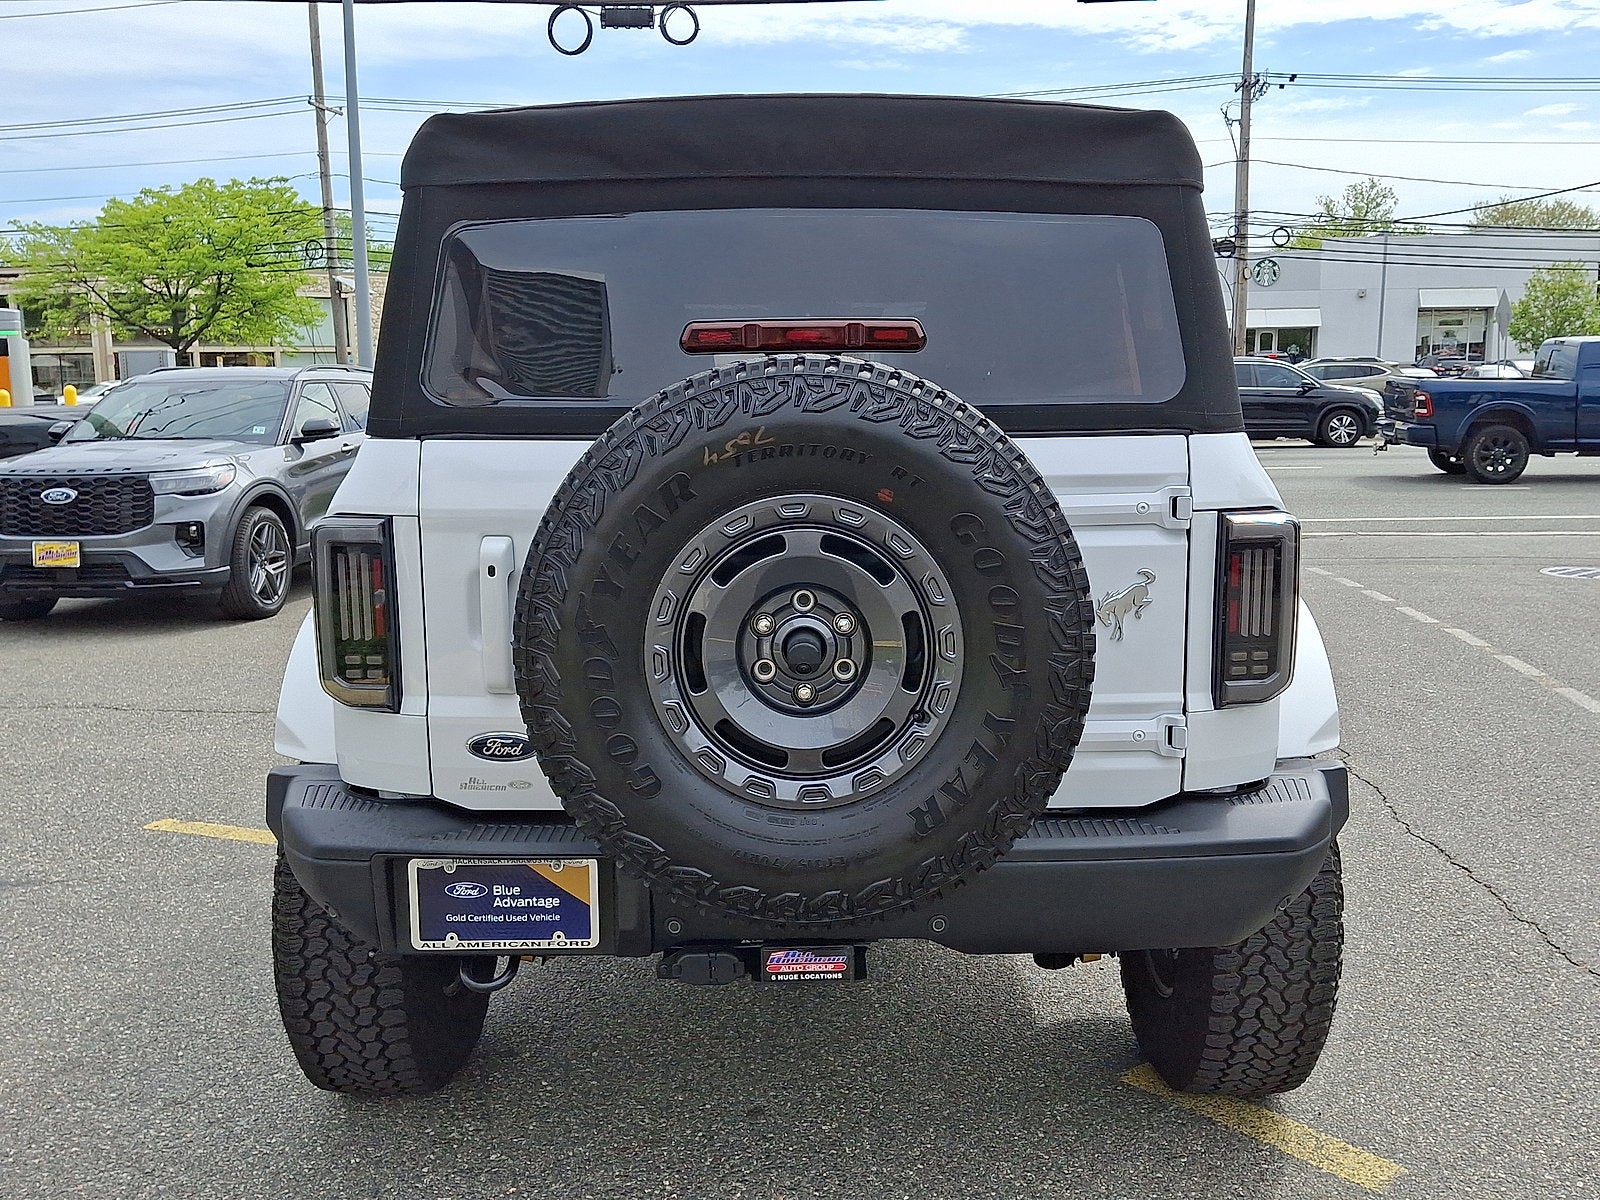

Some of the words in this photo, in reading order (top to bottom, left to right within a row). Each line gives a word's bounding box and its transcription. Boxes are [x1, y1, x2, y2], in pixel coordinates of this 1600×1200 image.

[731, 443, 873, 468] TERRITORY
[483, 738, 524, 756] Ford
[452, 884, 481, 897] Ford
[492, 885, 522, 896] Blue
[492, 897, 561, 909] Advantage
[445, 914, 467, 922] Gold
[467, 913, 504, 922] Certified
[505, 913, 528, 922] Used
[529, 913, 561, 922] Vehicle
[780, 964, 804, 972] AUTO
[805, 964, 835, 972] GROUP
